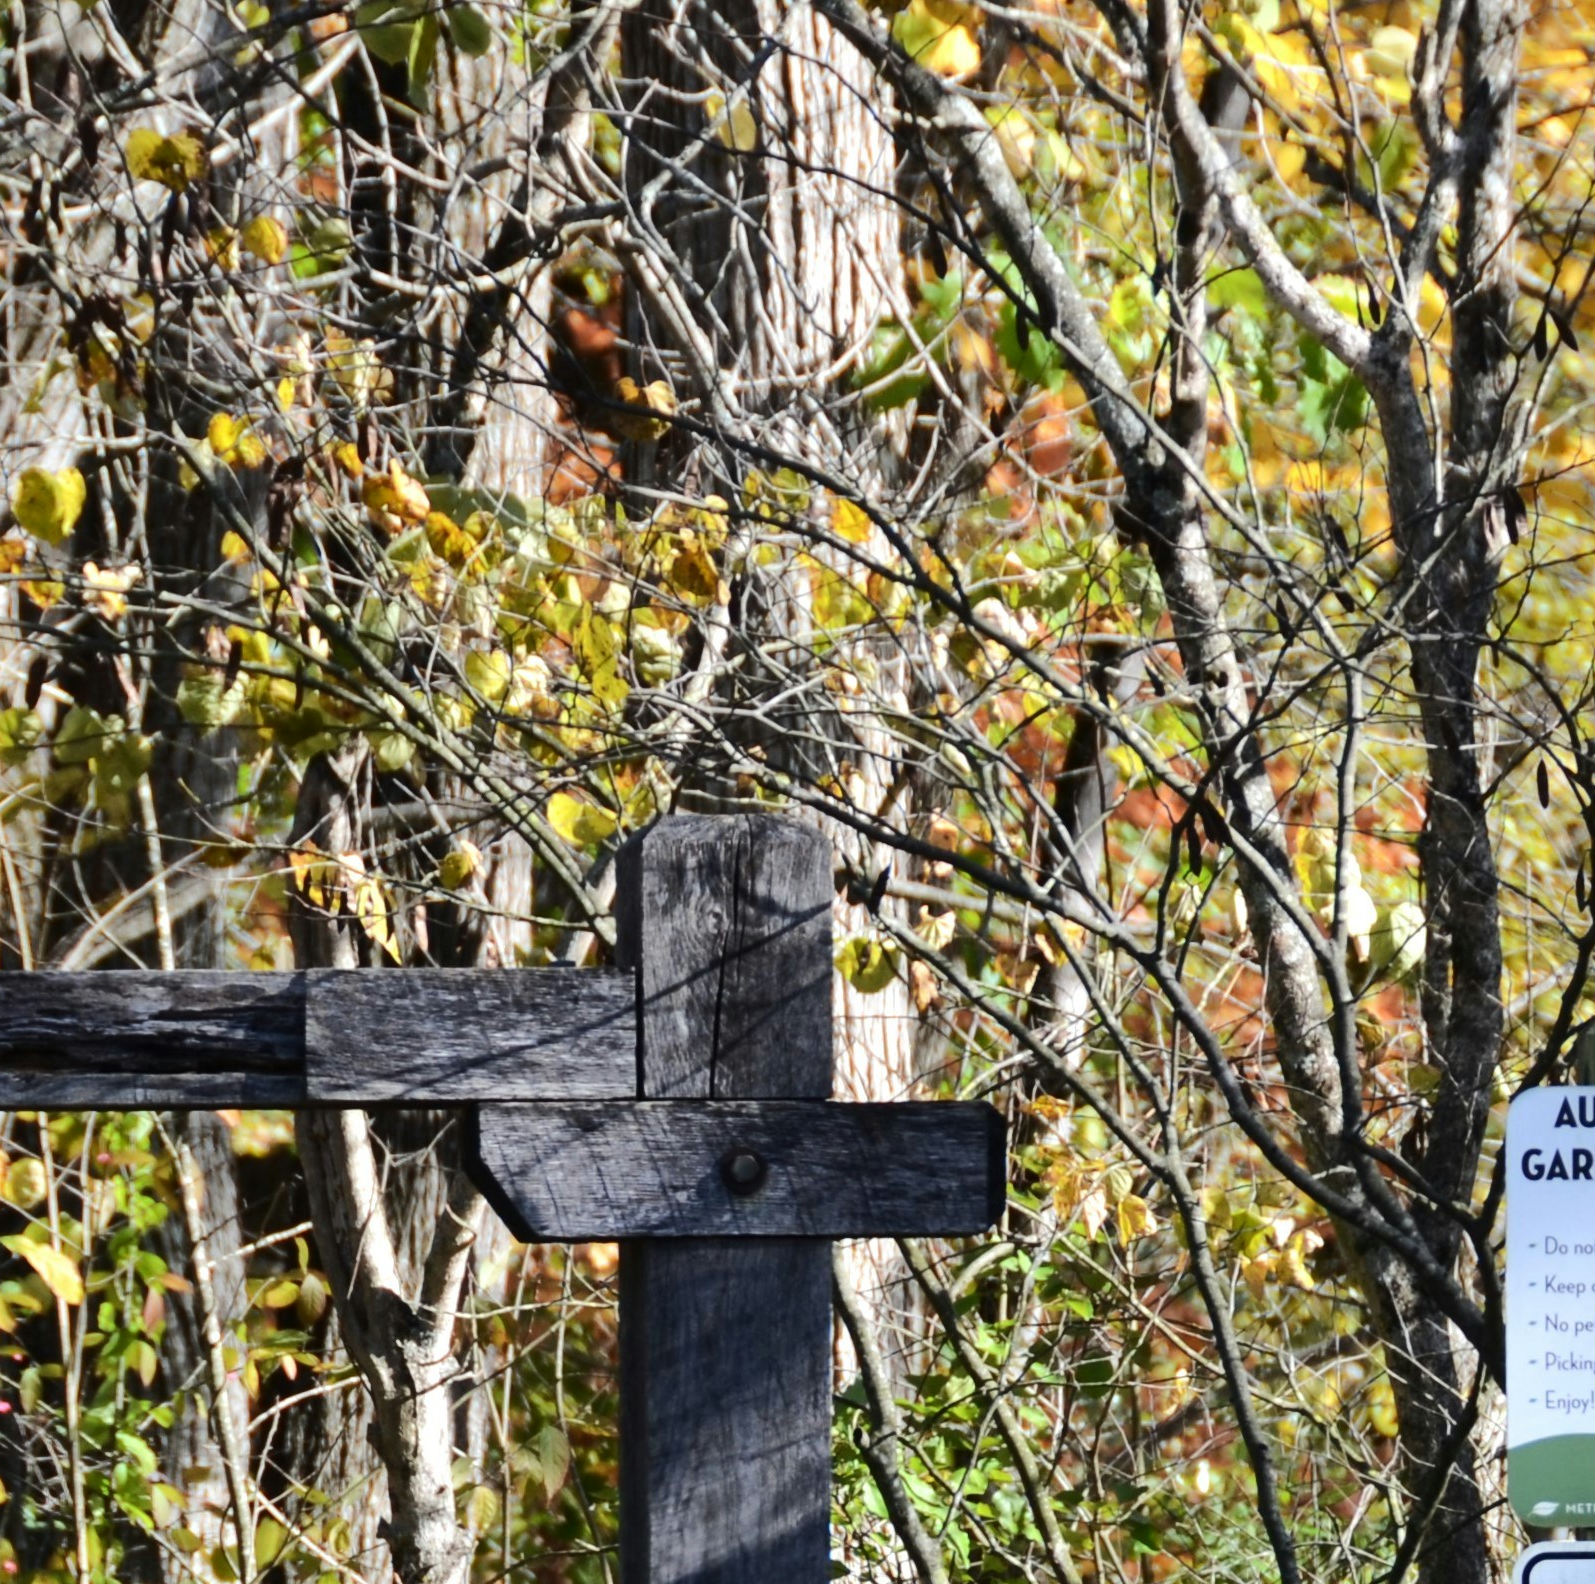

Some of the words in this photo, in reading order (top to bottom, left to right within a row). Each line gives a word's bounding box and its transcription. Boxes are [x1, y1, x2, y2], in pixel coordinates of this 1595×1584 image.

[1544, 1236, 1568, 1256] Do
[1545, 1275, 1586, 1298] Keep
[1545, 1315, 1569, 1332] No
[1545, 1391, 1595, 1414] Enjoy!
